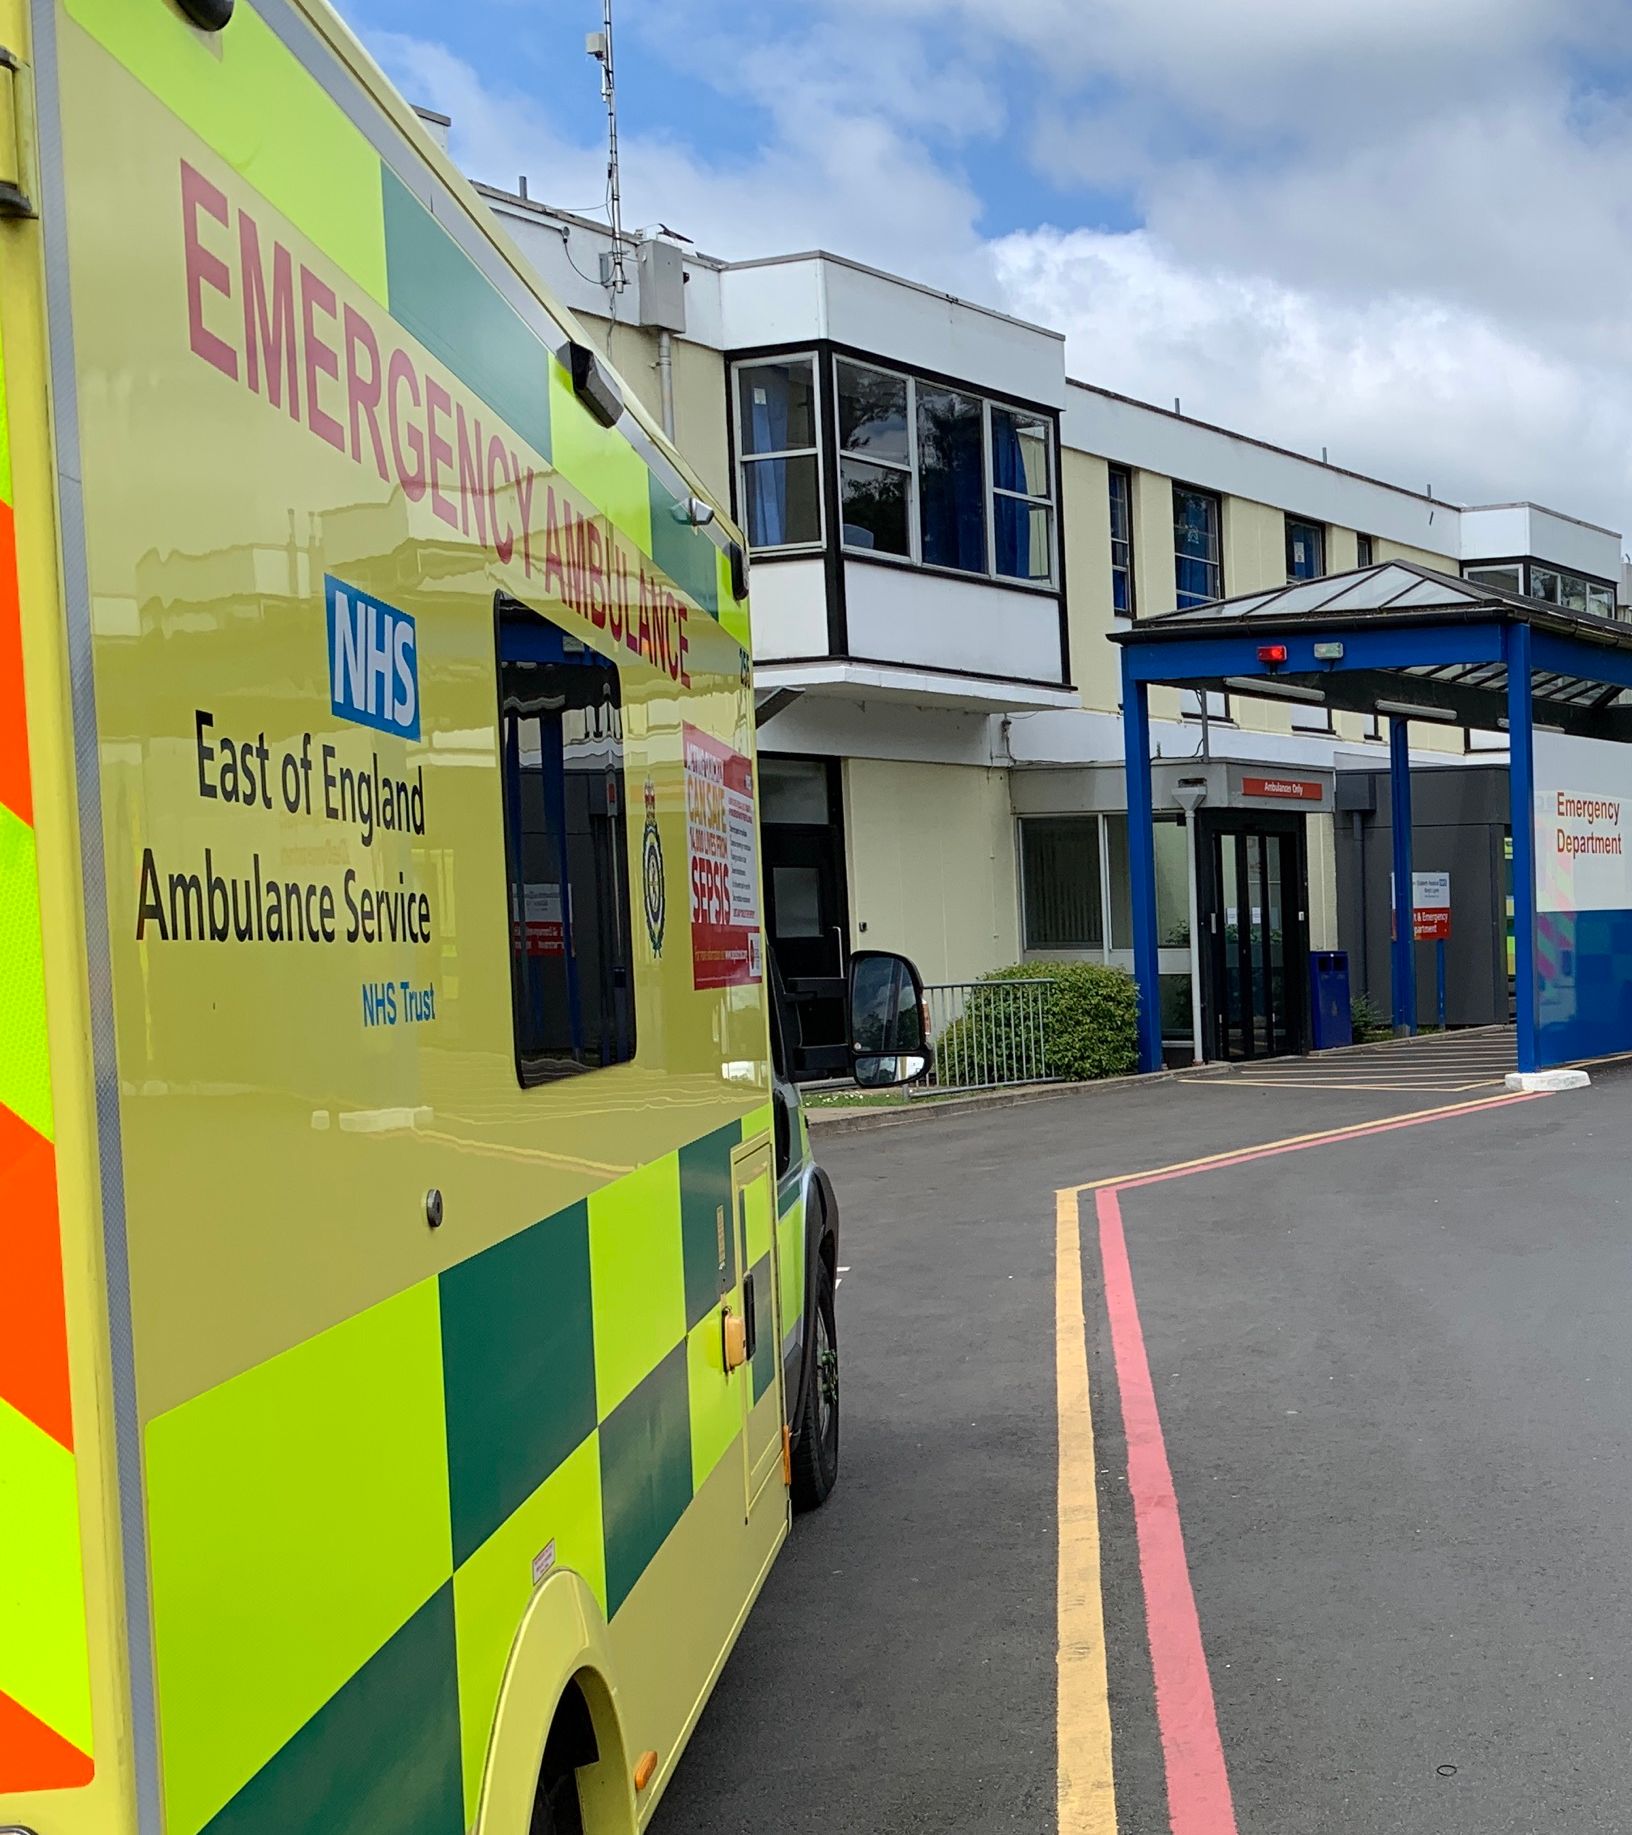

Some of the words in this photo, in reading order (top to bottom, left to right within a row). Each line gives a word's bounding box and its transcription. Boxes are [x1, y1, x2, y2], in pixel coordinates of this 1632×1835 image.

[180, 158, 533, 579] EMERGENCY
[545, 485, 691, 690] AMBULANCE
[335, 590, 415, 727] NHS
[195, 709, 272, 810] East
[281, 733, 312, 815] of
[322, 744, 425, 847] England
[1292, 783, 1303, 796] Only
[1557, 792, 1620, 826] Emergency
[1557, 829, 1622, 859] Department
[136, 848, 336, 943] Ambulance
[344, 868, 430, 944] Service
[691, 855, 731, 925] SEPSIS
[1414, 924, 1437, 937] partment
[1422, 911, 1448, 923] Emergency
[363, 982, 397, 1027] NHS
[400, 981, 435, 1022] Trust
